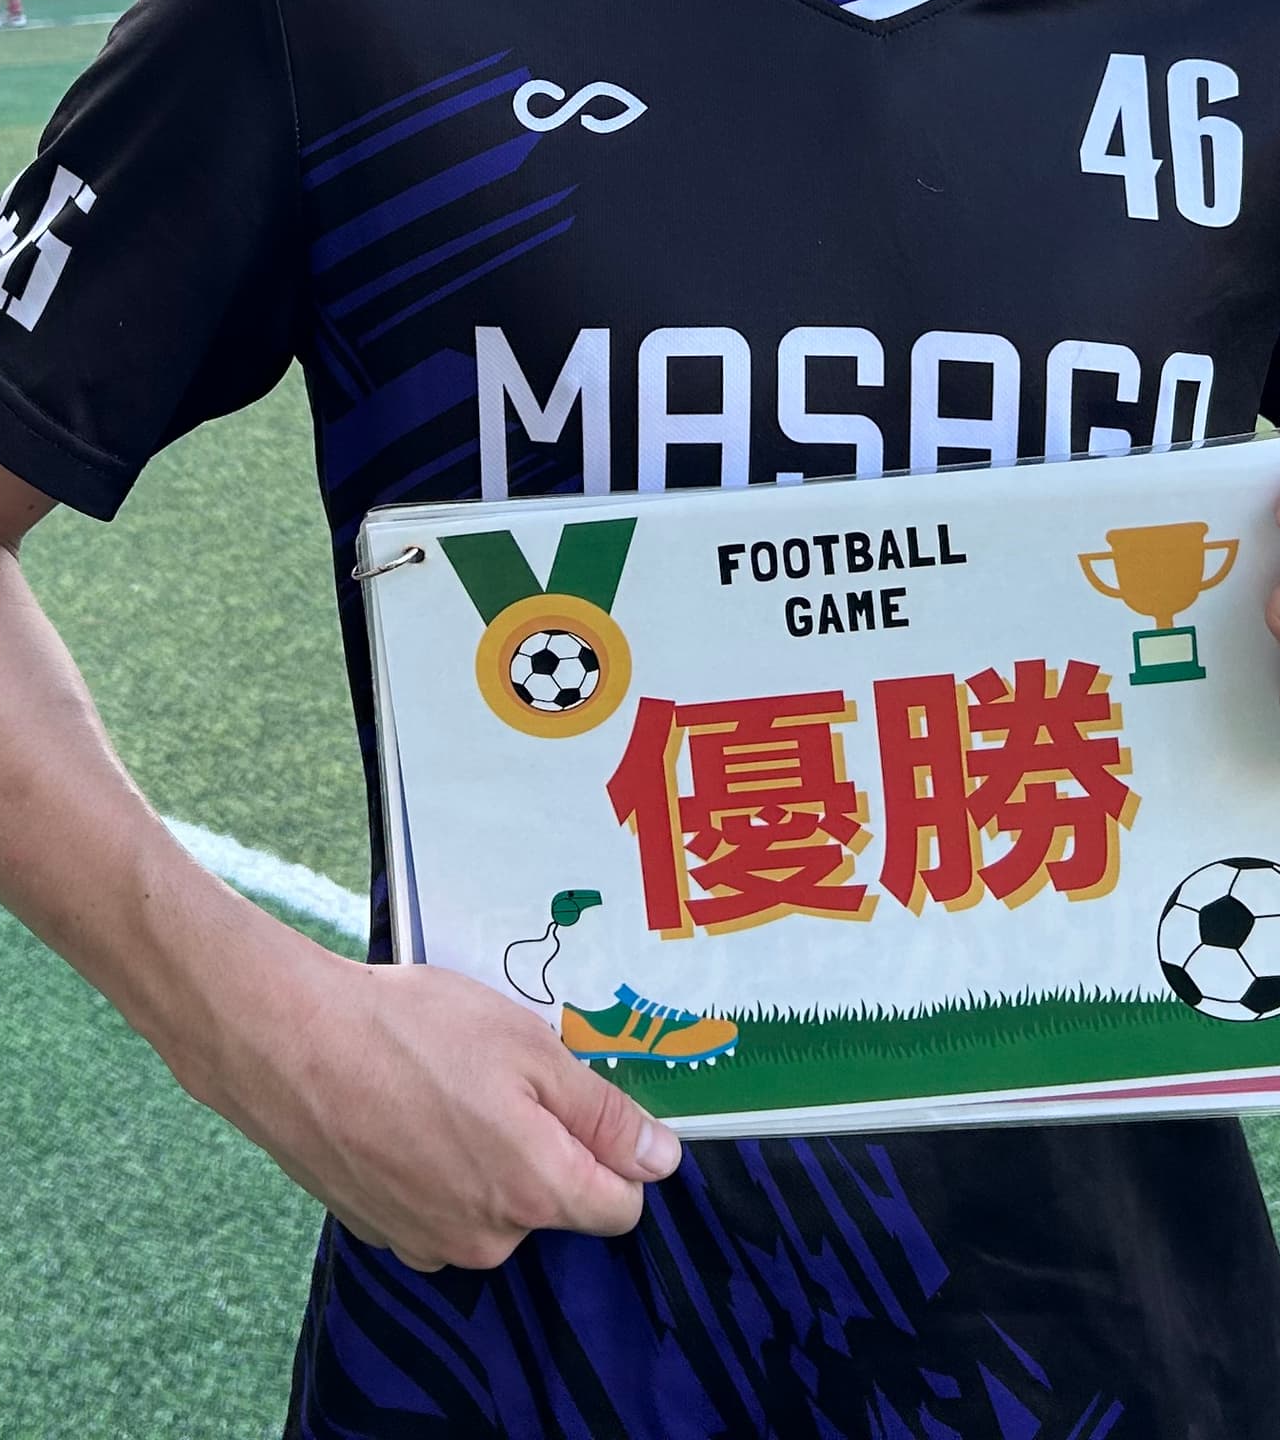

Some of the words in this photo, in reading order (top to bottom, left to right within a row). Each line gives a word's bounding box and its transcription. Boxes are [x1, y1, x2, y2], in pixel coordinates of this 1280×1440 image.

[1078, 53, 1245, 228] 46
[717, 523, 967, 586] FOOTBALL
[784, 588, 910, 638] GAME
[605, 658, 1146, 942] 優勝
